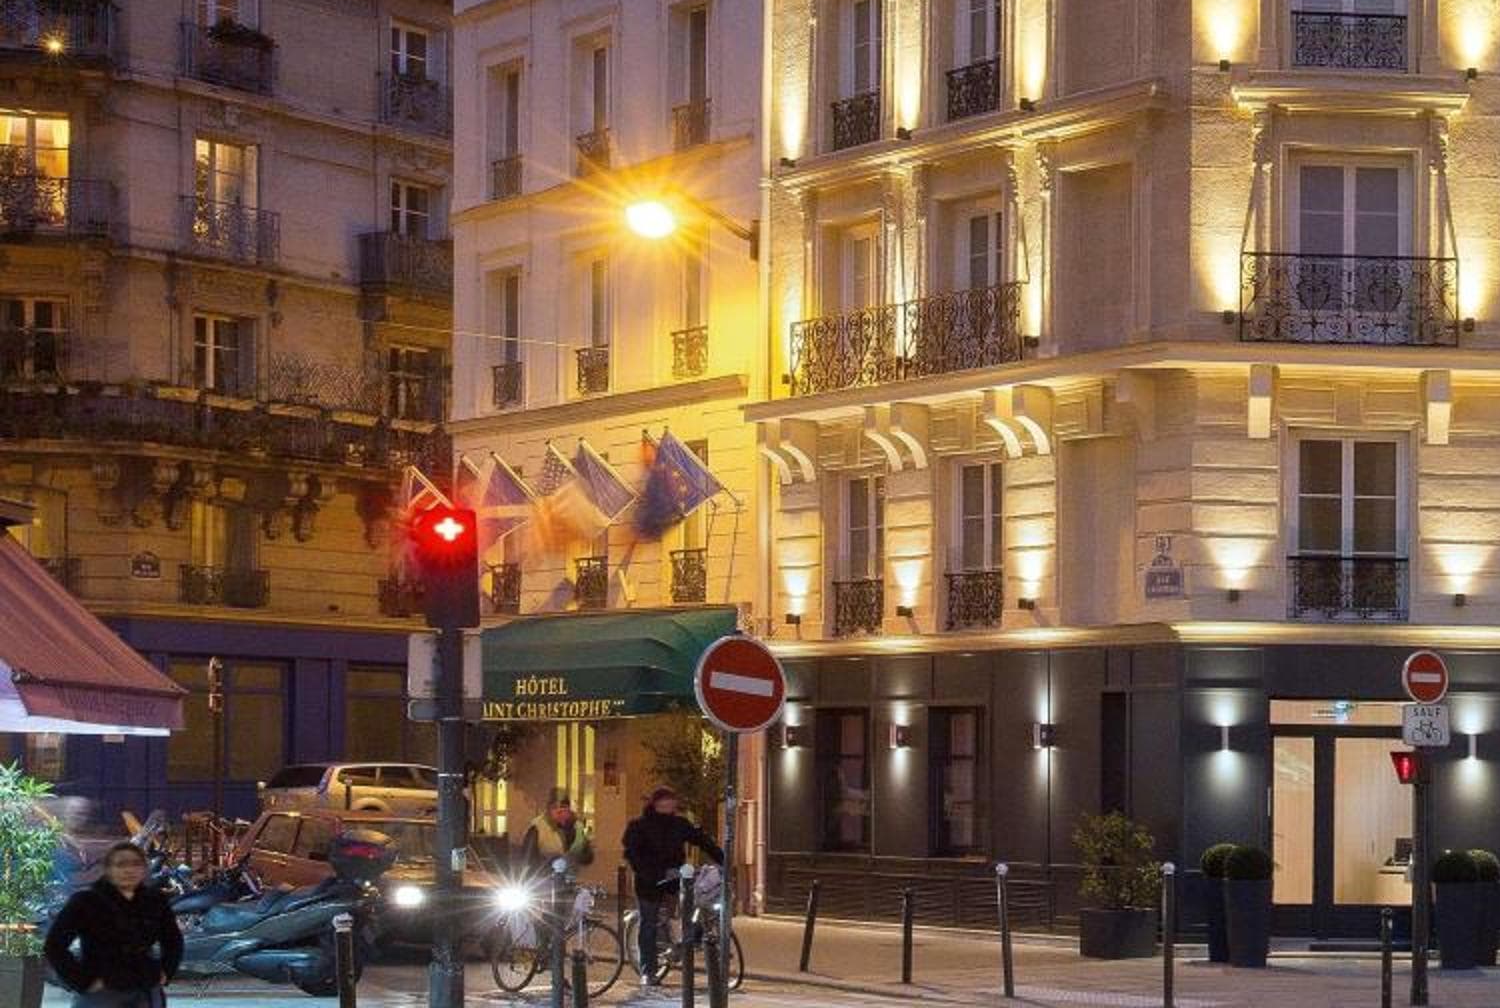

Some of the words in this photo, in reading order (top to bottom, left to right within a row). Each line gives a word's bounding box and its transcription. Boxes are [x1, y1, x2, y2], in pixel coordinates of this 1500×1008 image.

[515, 674, 568, 695] HÔTEL
[482, 701, 513, 717] AINT
[517, 699, 611, 718] CHRISTOPHE
[1413, 707, 1441, 717] SAUF
